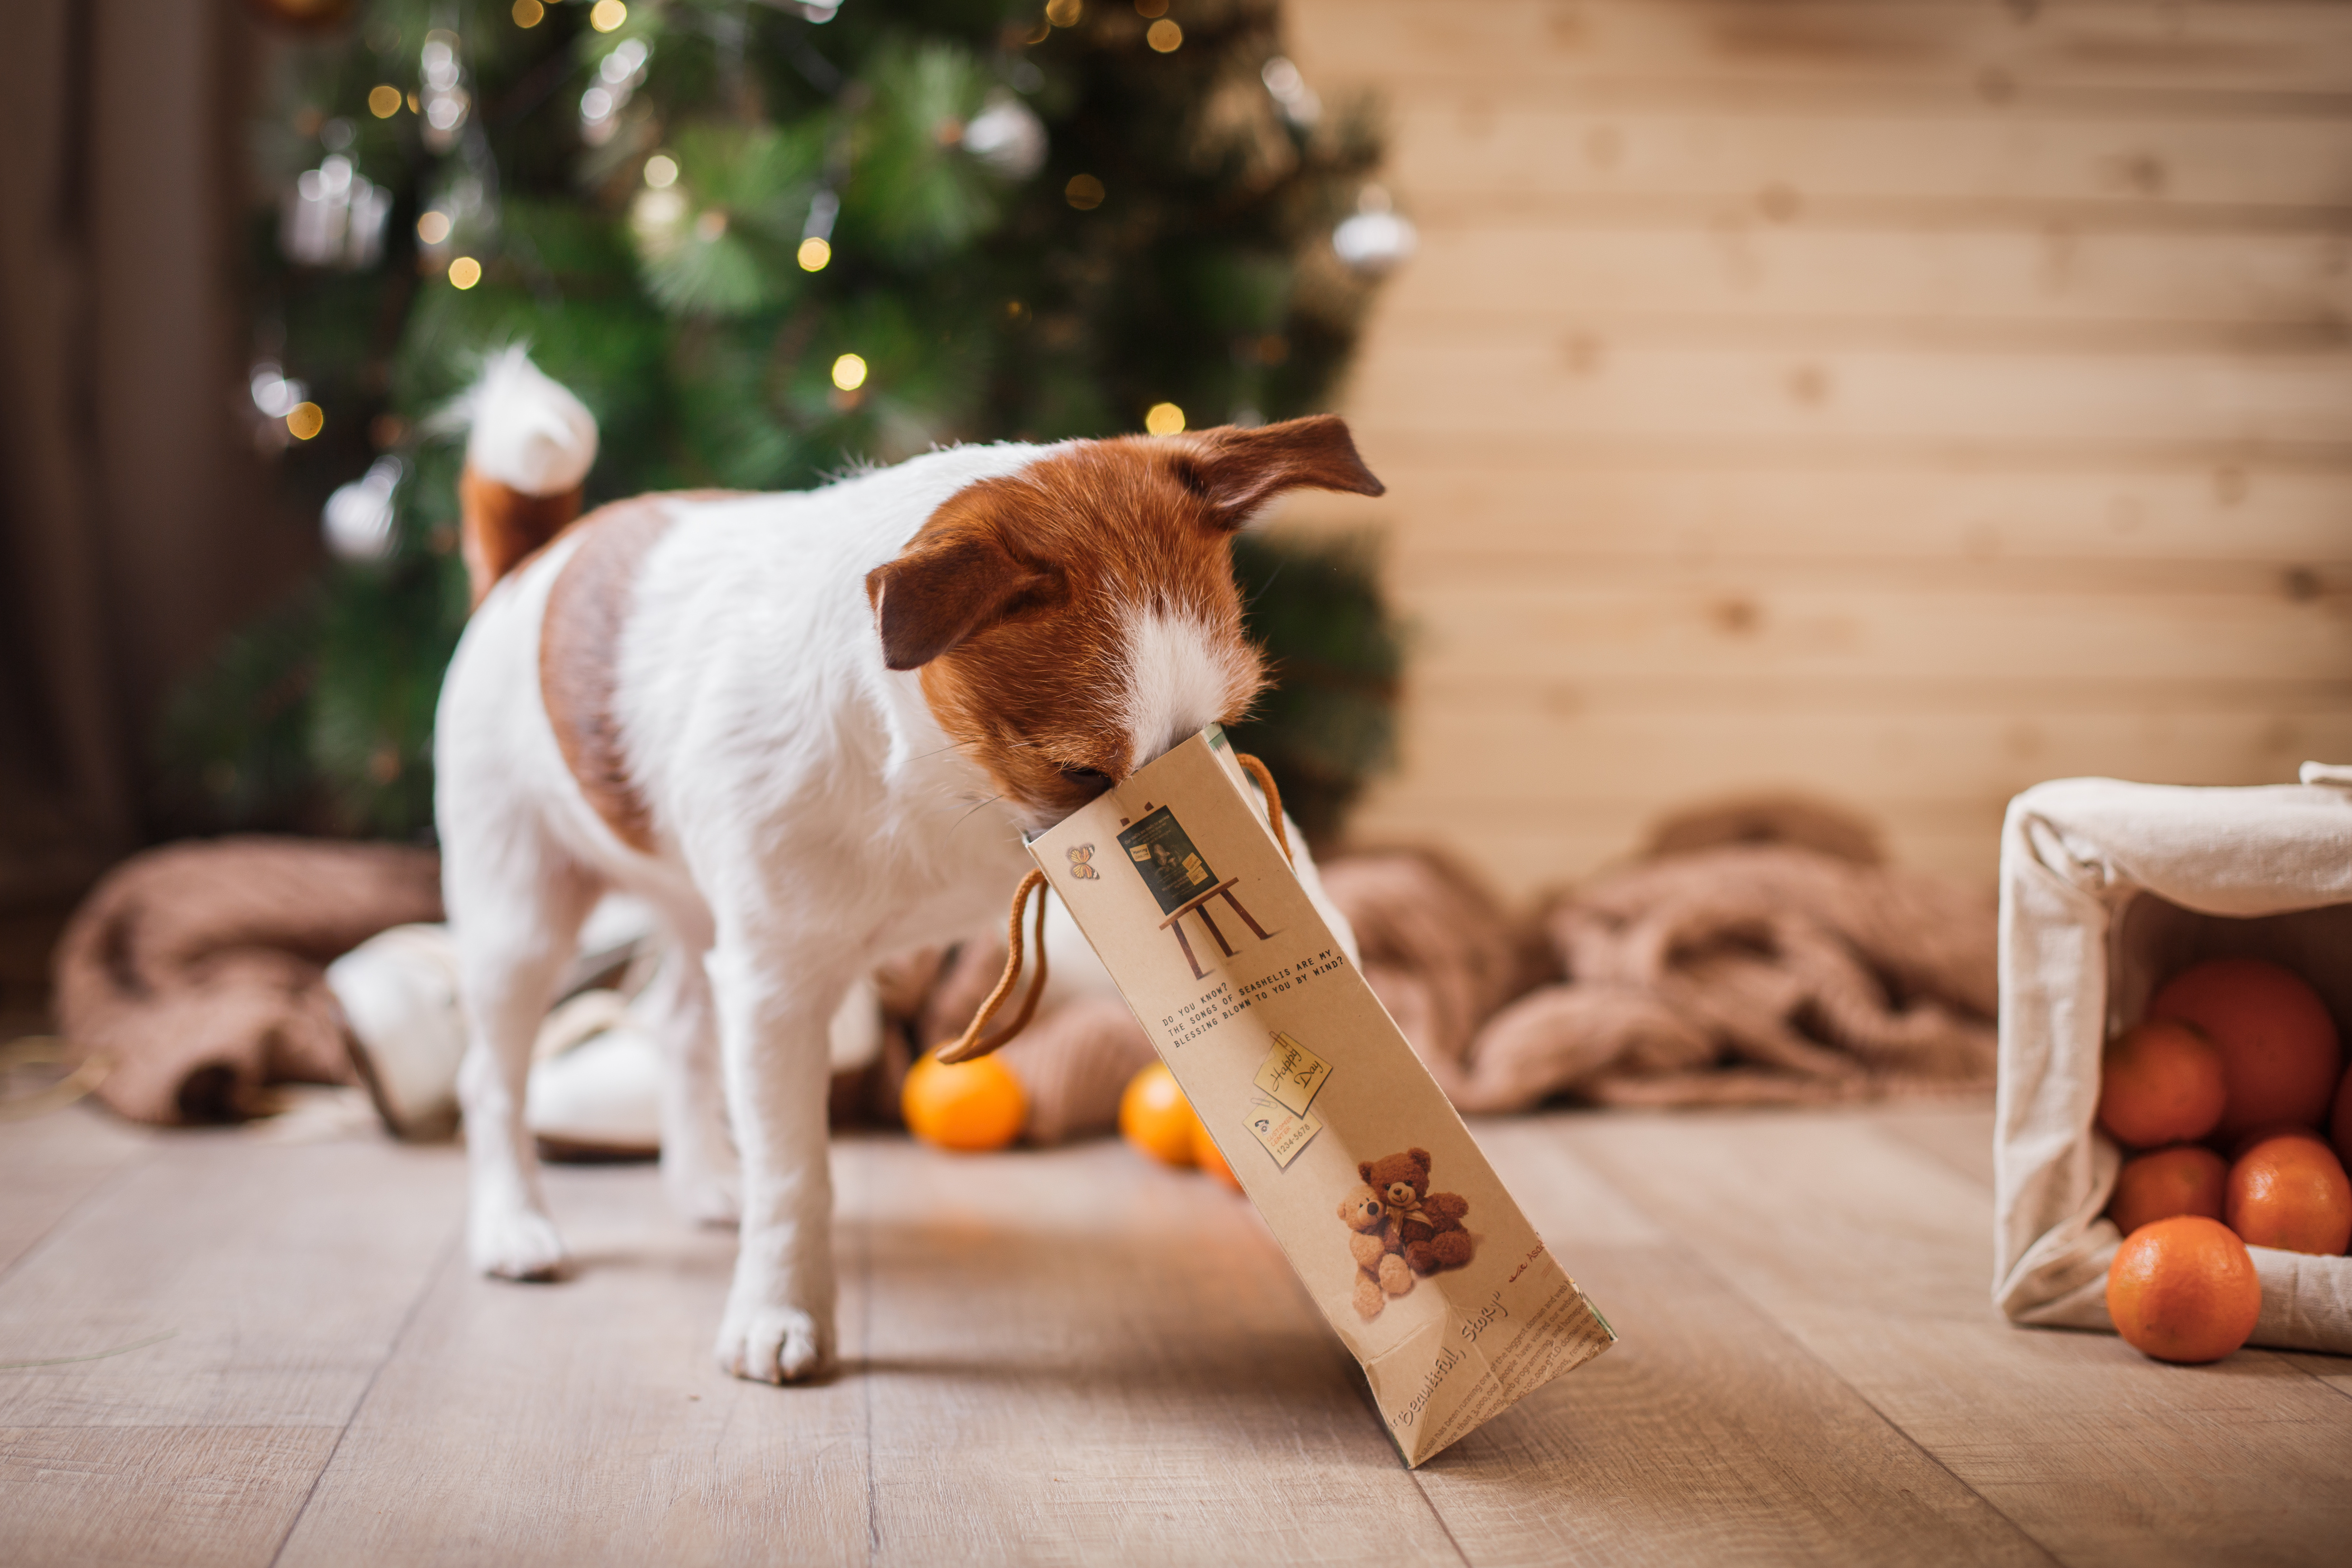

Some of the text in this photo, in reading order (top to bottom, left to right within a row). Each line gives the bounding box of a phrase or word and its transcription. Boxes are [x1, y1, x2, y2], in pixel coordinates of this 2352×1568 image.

[1162, 982, 1228, 1025] DO YOU KNOW?
[1168, 1023, 1185, 1036] THE
[1190, 1004, 1217, 1024] SONGS
[1222, 994, 1233, 1005] OF
[1296, 957, 1314, 970] ARE
[1319, 949, 1331, 960] MY
[1174, 956, 1343, 1047] BLESSING BLOWN TO YOU BY WIND?
[1270, 1048, 1302, 1092] Happy
[1294, 1060, 1323, 1089] Day
[1266, 1114, 1293, 1142] CUSTOMER
[1271, 1126, 1291, 1146] CENTER
[1277, 1123, 1310, 1155] 1234-5678
[1434, 1424, 1446, 1438] has
[1444, 1408, 1460, 1426] been
[1457, 1383, 1483, 1411] running
[1478, 1370, 1492, 1385] one
[1489, 1360, 1499, 1372] of
[1494, 1350, 1508, 1365] the
[1504, 1327, 1530, 1354] biggest
[1524, 1306, 1547, 1329] domain
[1543, 1295, 1556, 1309] and
[1553, 1282, 1568, 1298] web
[1456, 1414, 1472, 1431] than
[1497, 1358, 1519, 1383] people
[1515, 1341, 1532, 1359] have
[1530, 1320, 1551, 1343] visited
[1549, 1310, 1560, 1323] our
[1501, 1381, 1516, 1397] web
[1551, 1324, 1564, 1339] and
